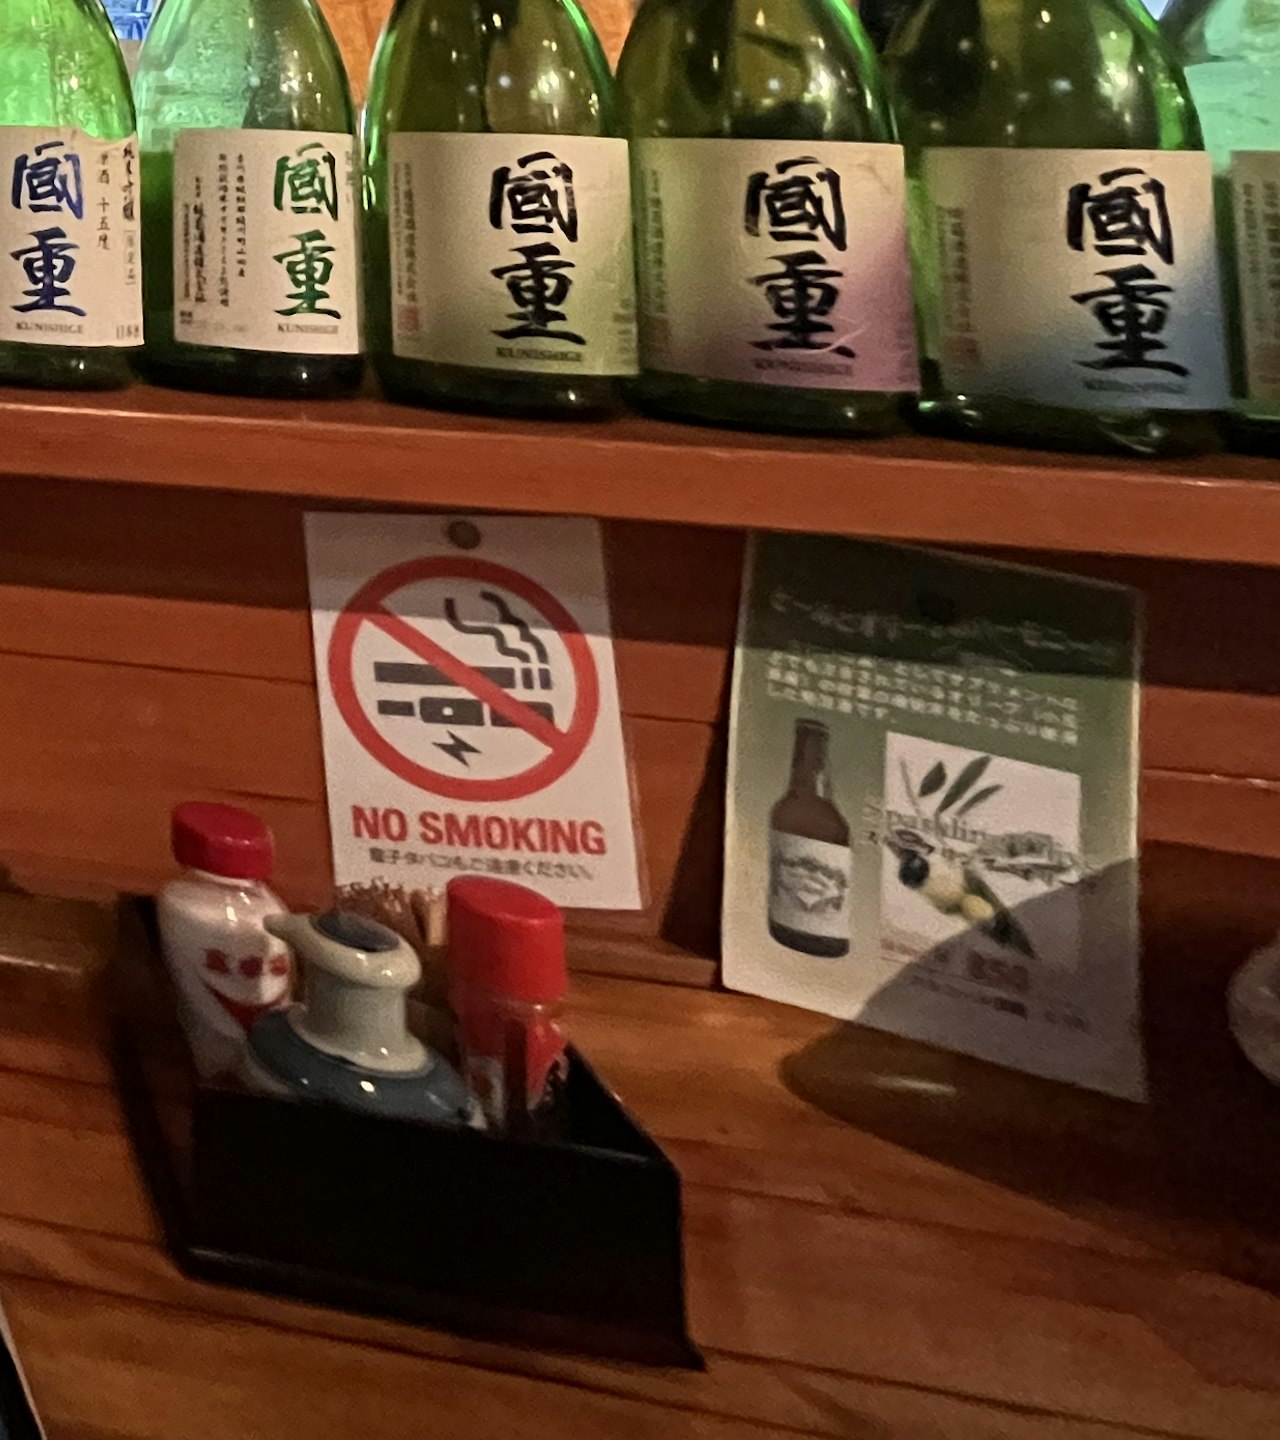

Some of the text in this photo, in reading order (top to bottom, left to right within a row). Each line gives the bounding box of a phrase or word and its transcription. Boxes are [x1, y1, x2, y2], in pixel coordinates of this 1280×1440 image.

[9, 140, 88, 317] 國重
[272, 142, 343, 320] 國重
[489, 151, 587, 346] 國重
[743, 155, 857, 359] 國重
[1067, 167, 1192, 378] 國重
[351, 804, 608, 856] NO SMOKING
